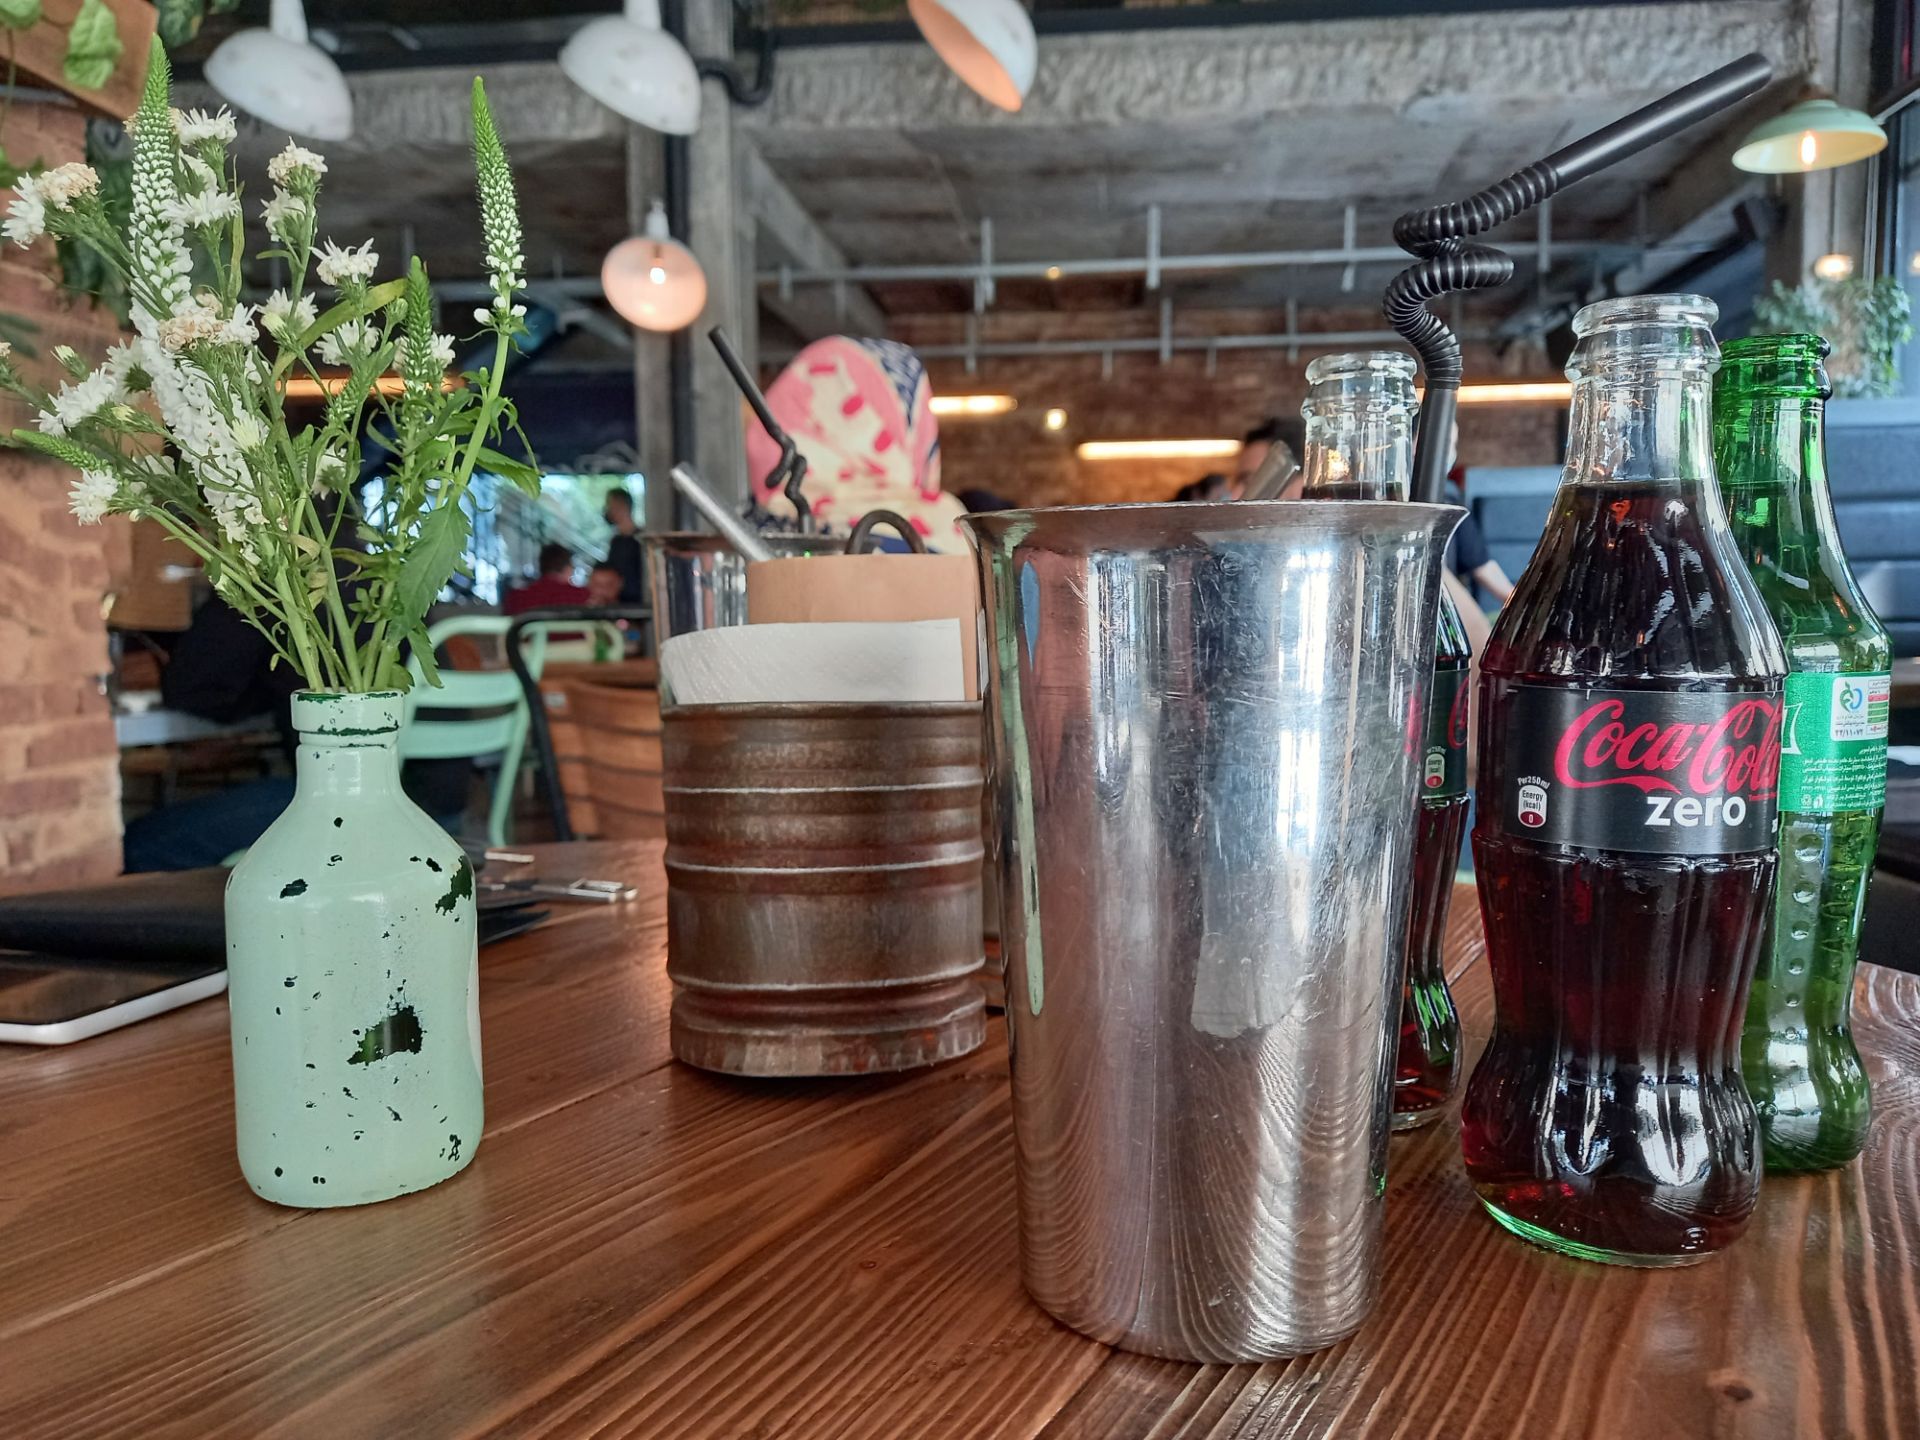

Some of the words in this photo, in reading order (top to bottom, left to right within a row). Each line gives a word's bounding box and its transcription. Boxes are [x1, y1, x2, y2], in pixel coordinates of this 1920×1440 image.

[1522, 790, 1543, 802] Energy
[1523, 800, 1541, 811] (kcal)
[1644, 796, 1746, 827] zero
[1528, 814, 1534, 824] 0
